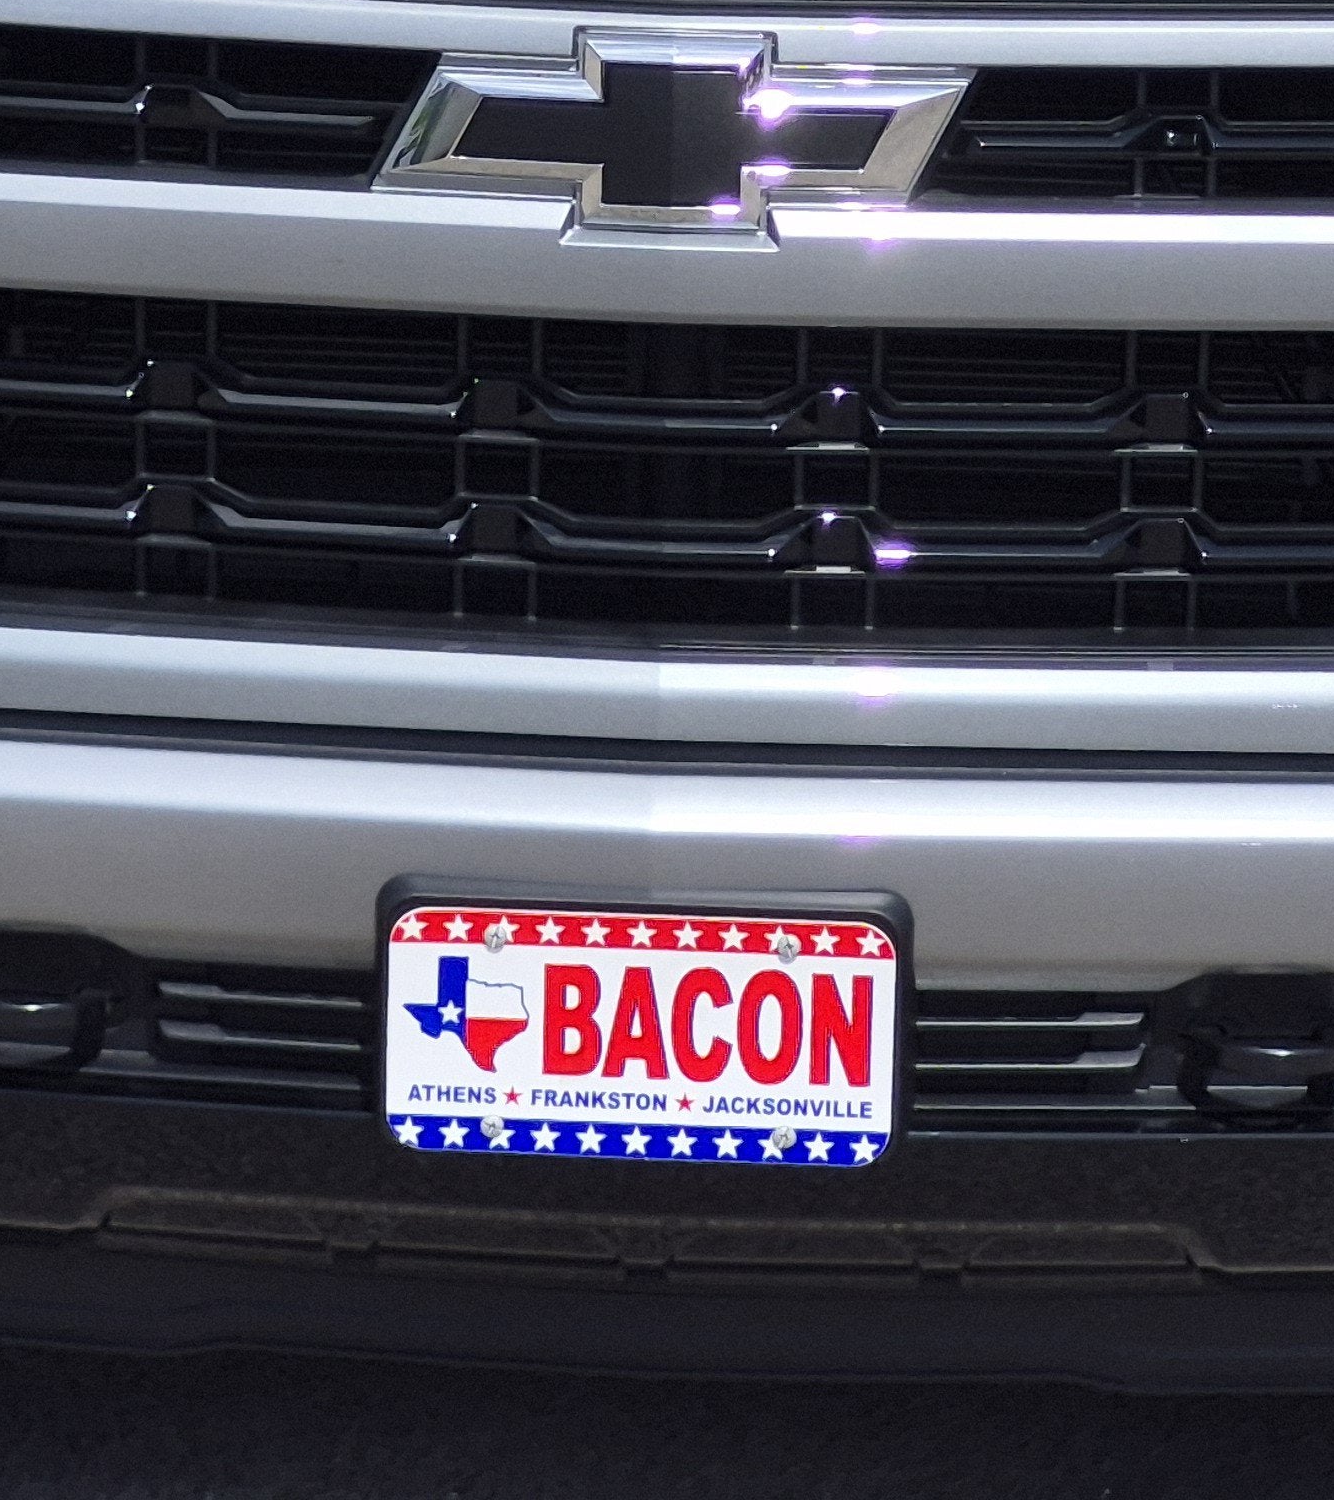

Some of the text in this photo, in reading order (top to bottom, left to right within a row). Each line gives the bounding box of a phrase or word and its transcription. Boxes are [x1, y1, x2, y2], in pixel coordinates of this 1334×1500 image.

[542, 962, 874, 1088] BACON
[408, 1083, 873, 1119] ATHENS FRANKSTON JACKSONVILLE
